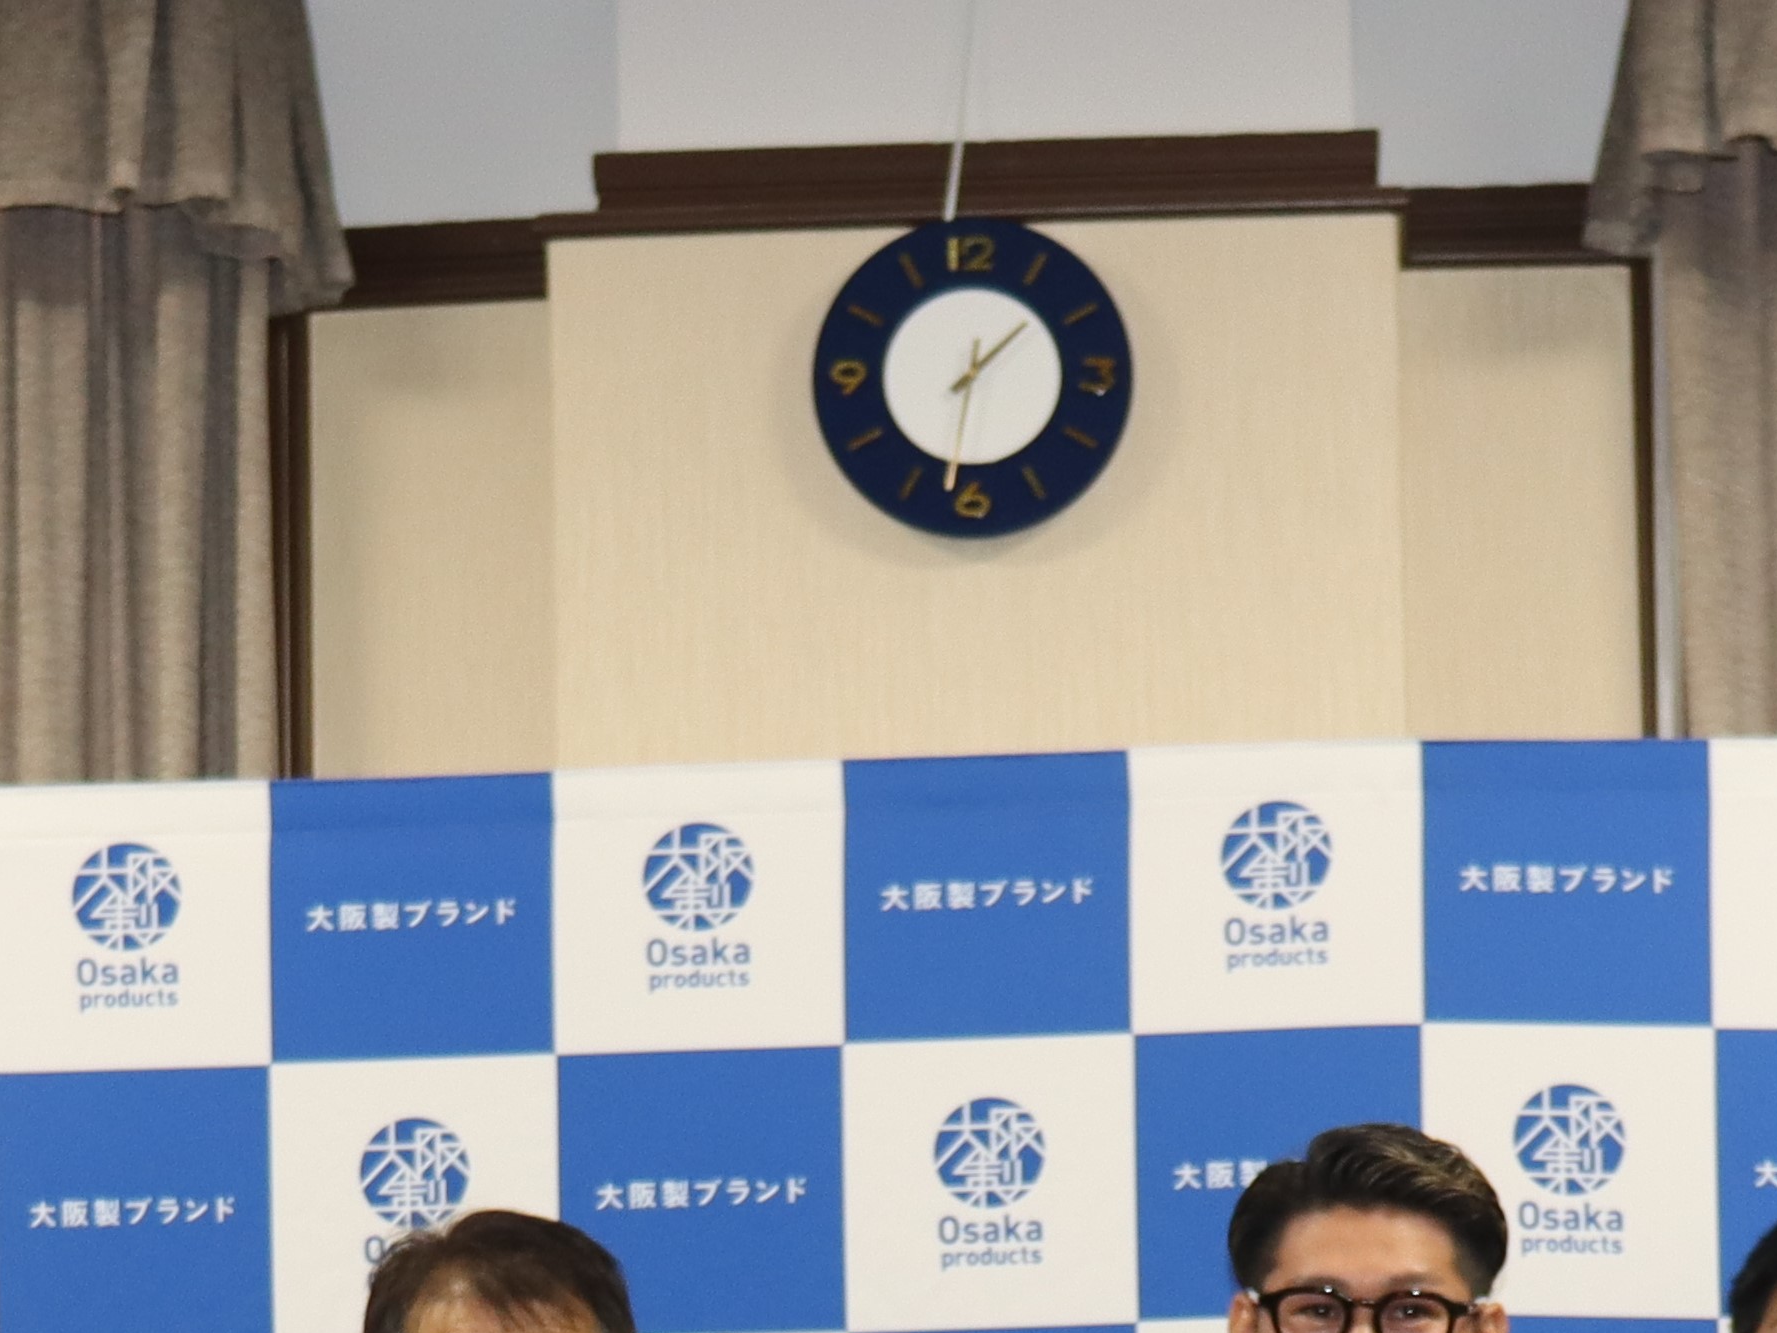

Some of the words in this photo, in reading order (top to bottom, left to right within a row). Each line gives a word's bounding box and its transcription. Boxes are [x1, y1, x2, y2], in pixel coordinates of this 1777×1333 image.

[945, 235, 996, 273] 12
[829, 358, 867, 396] 9
[1079, 355, 1116, 397] 3
[953, 481, 992, 519] 6
[1459, 863, 1673, 894] 大阪製ブランド
[881, 878, 1092, 912] 大阪製ブランド
[306, 899, 515, 932] 大阪製ブランド
[1225, 917, 1329, 945] Osaka
[646, 938, 751, 966] Osaka
[1228, 949, 1327, 969] products
[77, 957, 179, 986] Osaka
[650, 971, 749, 991] products
[80, 990, 177, 1010] products
[596, 1178, 806, 1210] 大阪製ブランド
[29, 1197, 235, 1229] 大阪製ブランド
[1518, 1202, 1624, 1232] Osaka
[937, 1215, 1043, 1244] Osaka
[941, 1247, 1042, 1268] products
[1521, 1235, 1624, 1257] products
